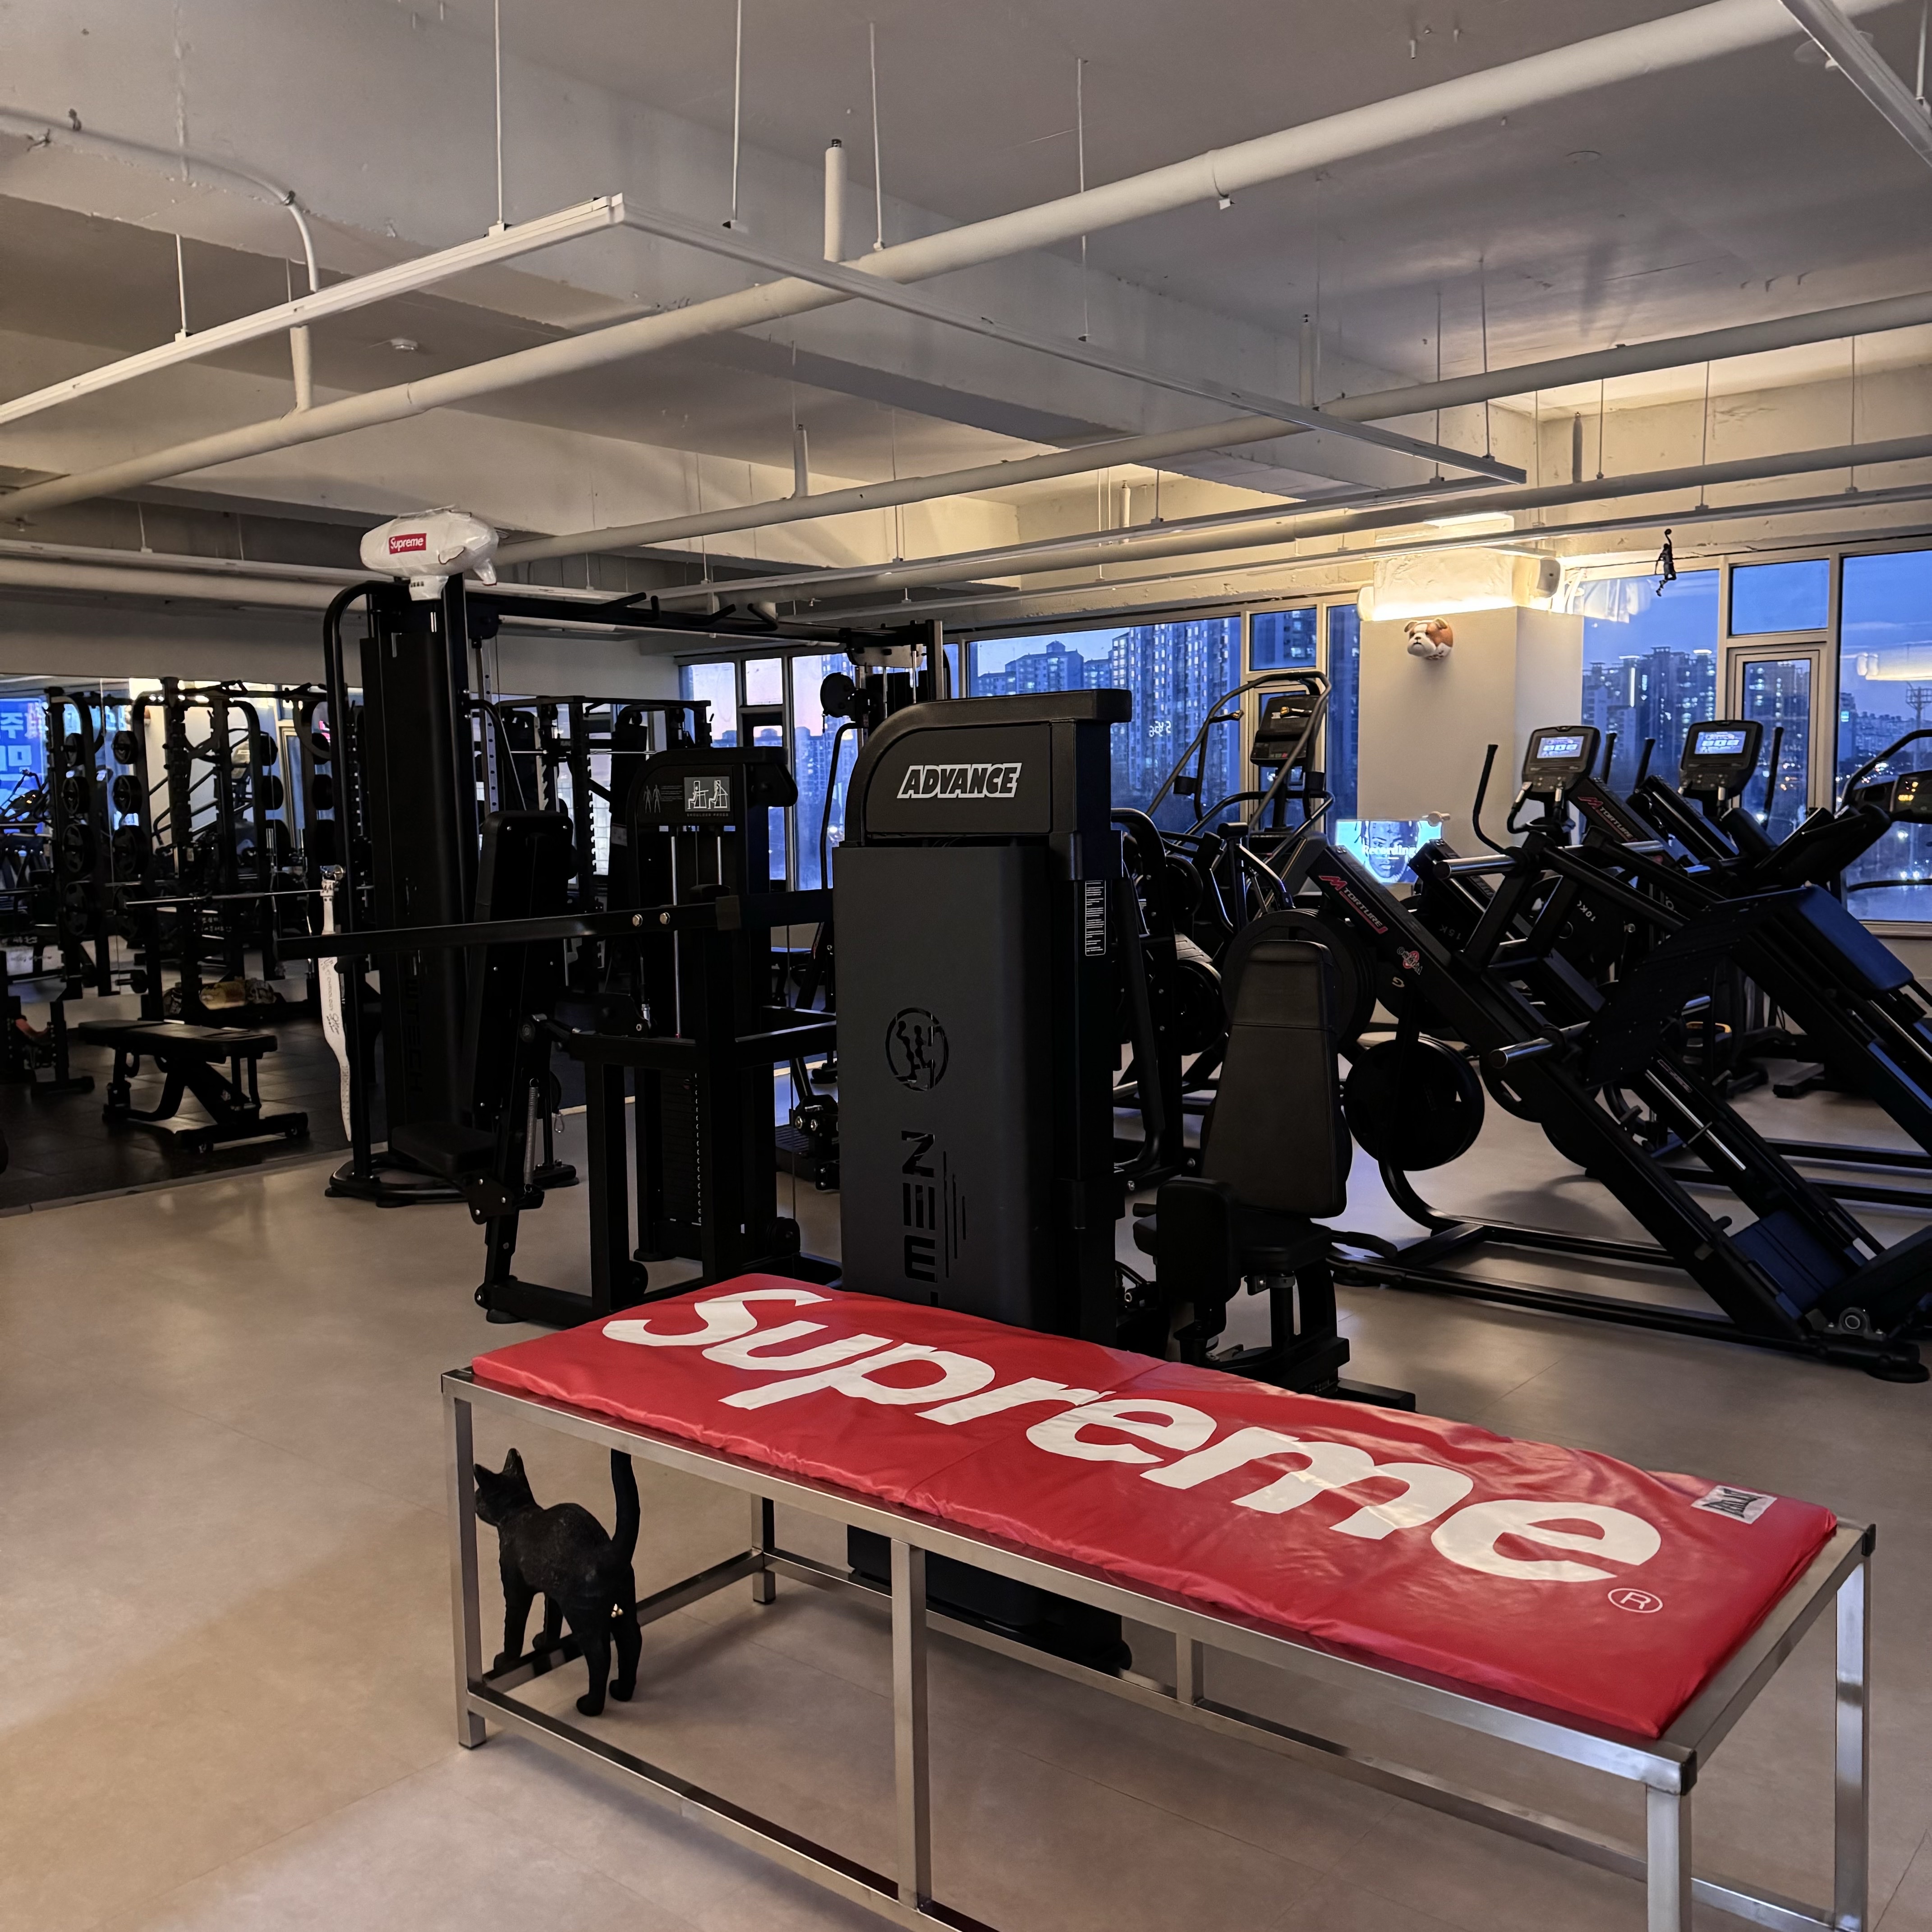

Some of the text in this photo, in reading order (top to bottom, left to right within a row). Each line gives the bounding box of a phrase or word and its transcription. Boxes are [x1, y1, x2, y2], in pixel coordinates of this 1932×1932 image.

[390, 537, 424, 552] Supreme
[897, 762, 1022, 799] ADVANCE
[1598, 805, 1633, 839] TORTURE
[1363, 844, 1417, 859] Recording
[1344, 887, 1383, 927] TORTURE
[603, 1289, 1661, 1582] Supreme
